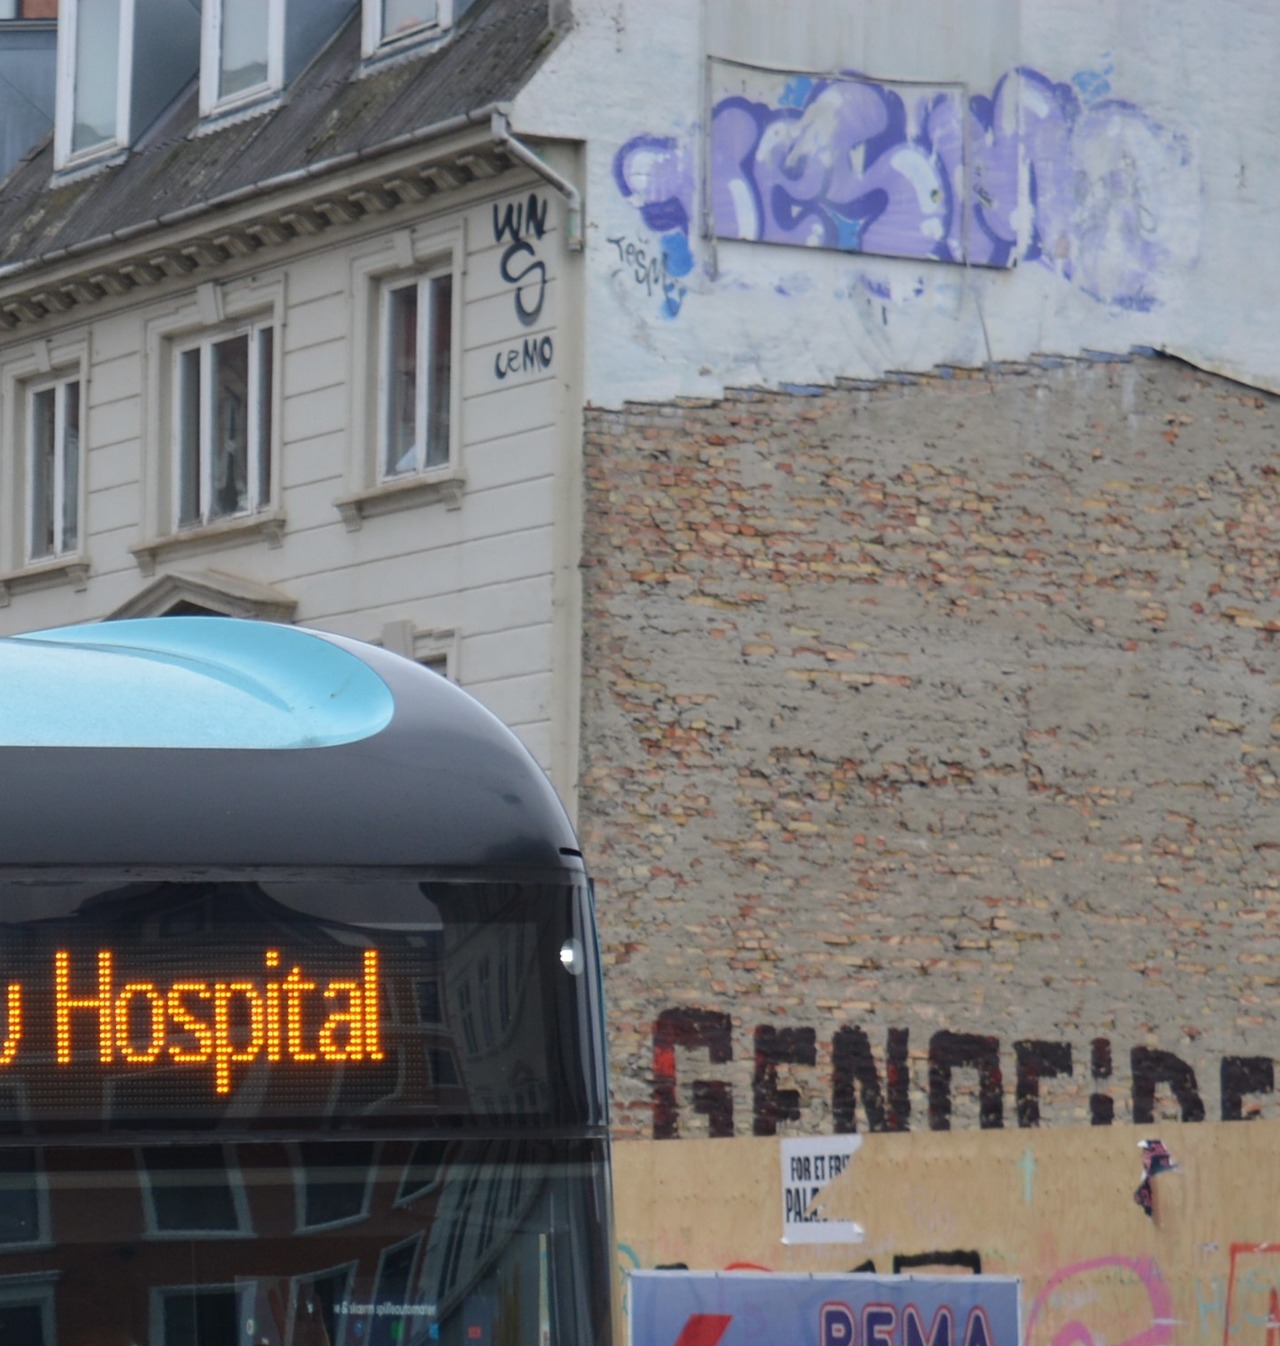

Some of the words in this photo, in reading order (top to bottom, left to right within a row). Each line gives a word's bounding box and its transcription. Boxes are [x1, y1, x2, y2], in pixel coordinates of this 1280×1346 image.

[54, 949, 385, 1095] Hospital
[790, 1155, 812, 1181] FOR
[814, 1155, 826, 1181] ET
